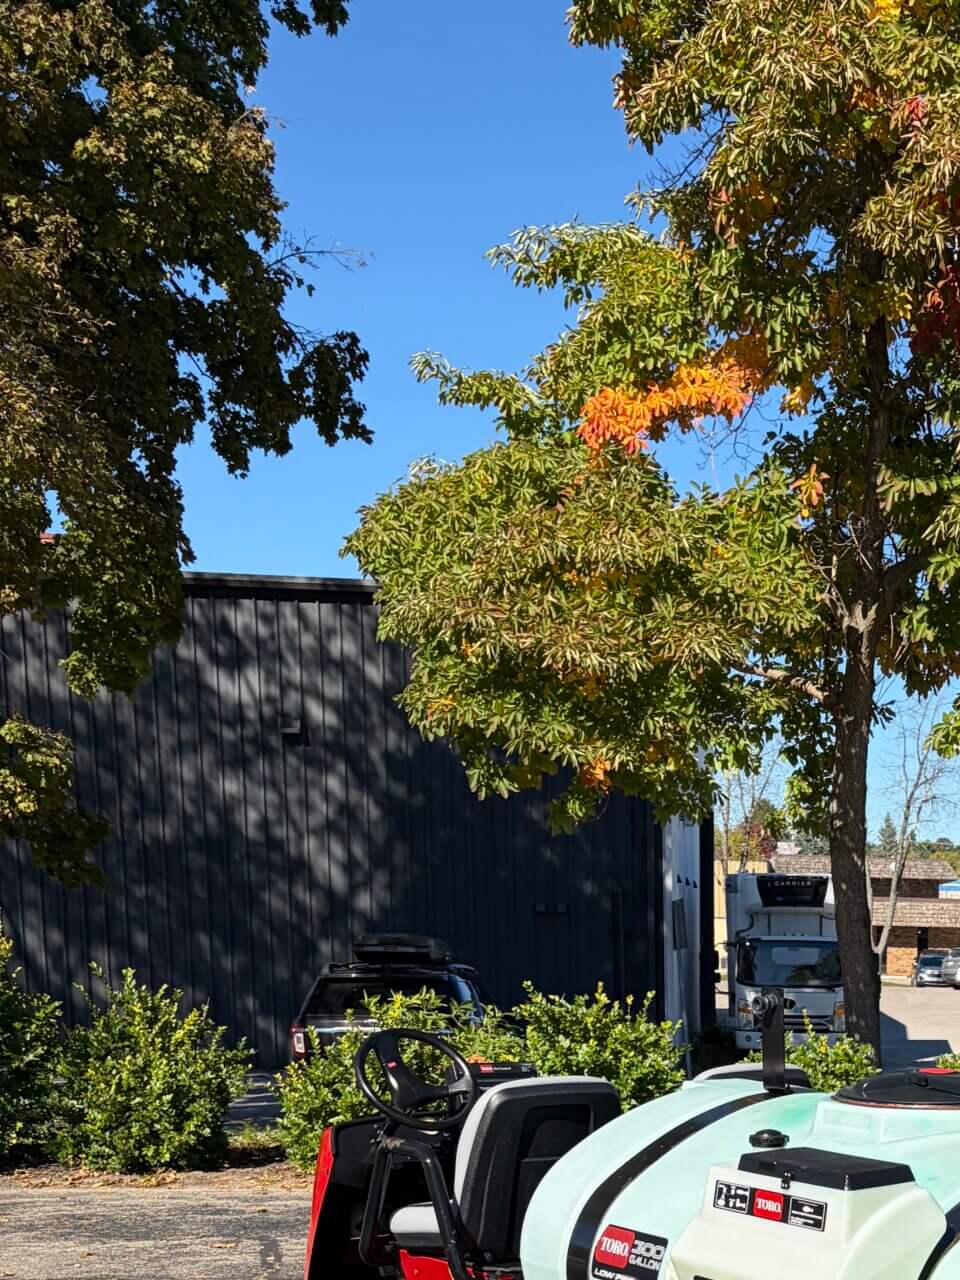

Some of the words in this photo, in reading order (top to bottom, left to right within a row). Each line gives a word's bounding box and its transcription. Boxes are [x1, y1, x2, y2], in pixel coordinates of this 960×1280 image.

[756, 1198, 781, 1213] TORO
[601, 1236, 629, 1256] TORO
[632, 1239, 665, 1260] 300
[629, 1255, 661, 1271] GALLON
[594, 1268, 615, 1279] LOW
